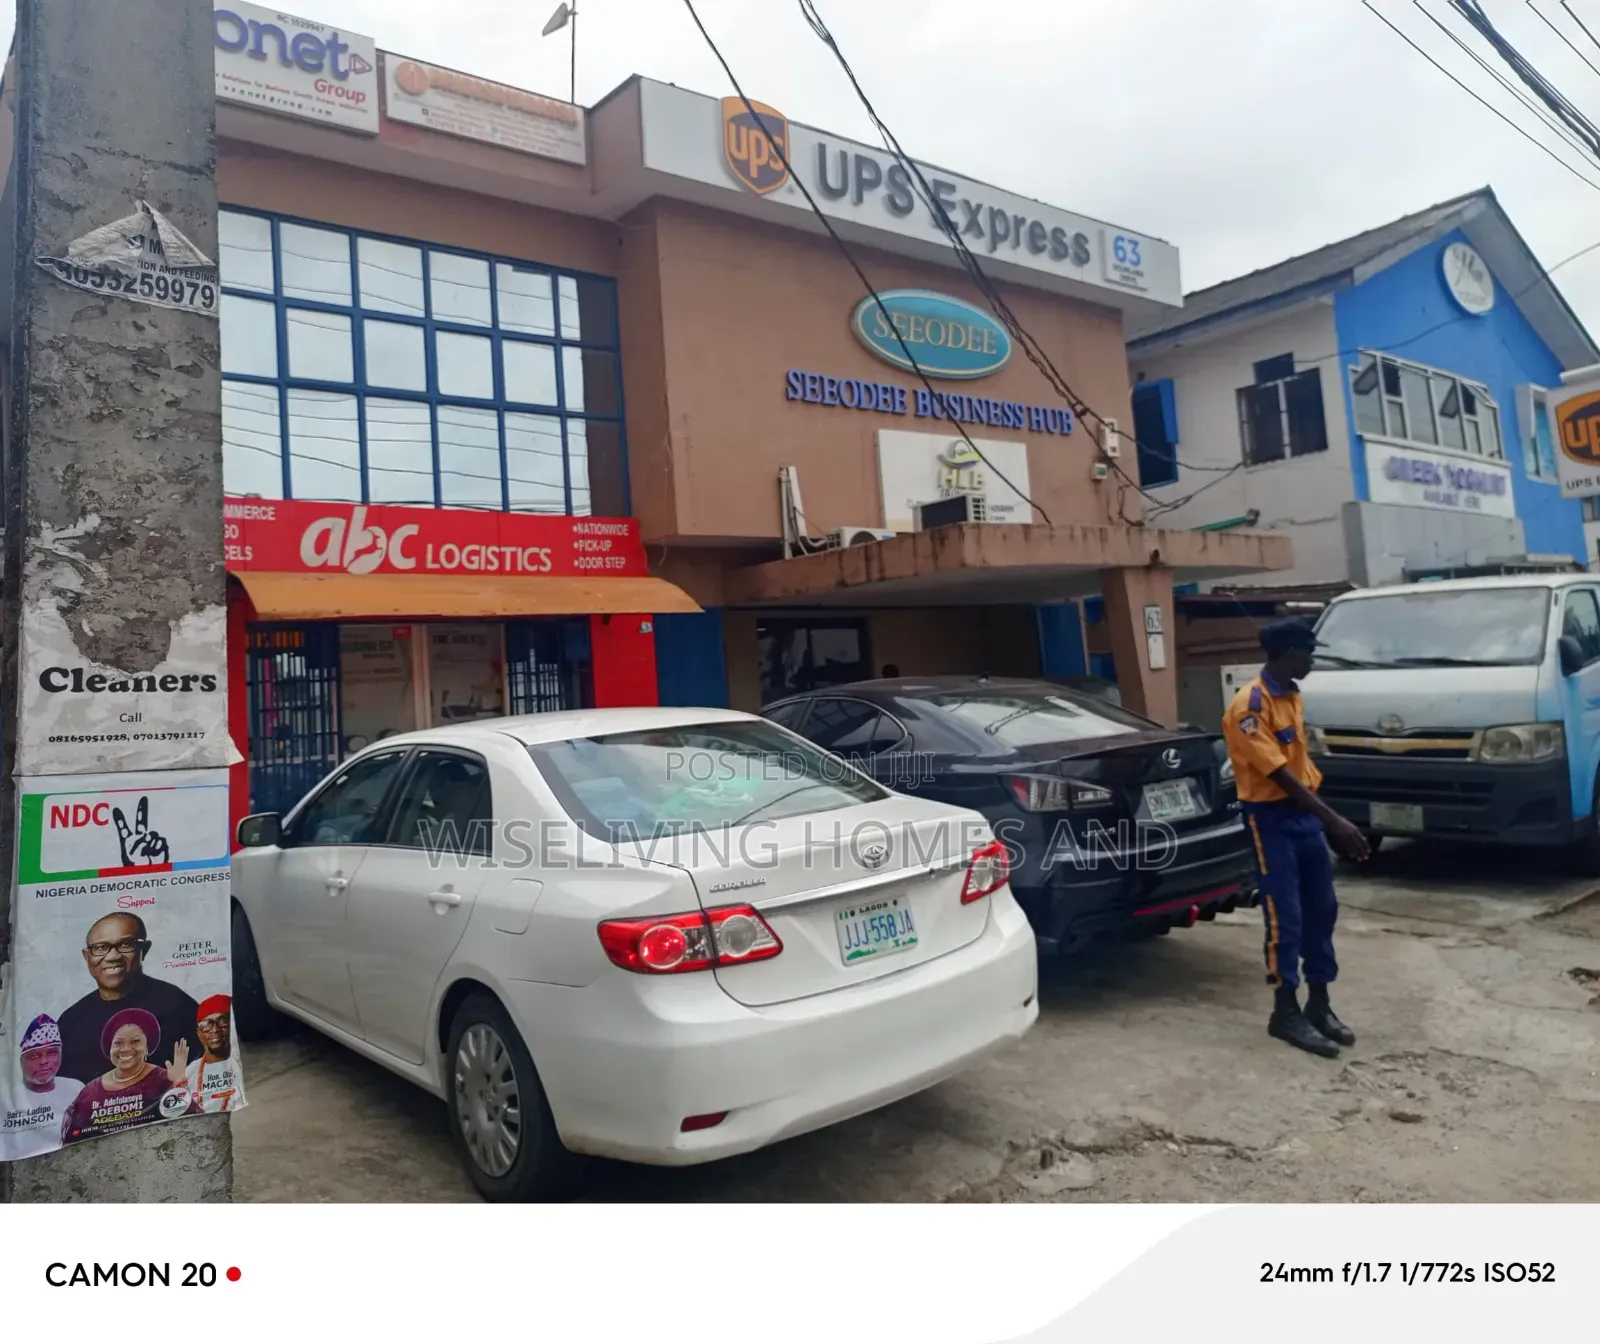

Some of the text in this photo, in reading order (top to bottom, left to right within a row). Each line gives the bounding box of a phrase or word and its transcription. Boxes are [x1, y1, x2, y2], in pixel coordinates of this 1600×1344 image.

[213, 10, 349, 81] onet
[314, 78, 366, 105] Group
[728, 121, 786, 179] ups
[817, 142, 1092, 266] UPS Express
[1113, 234, 1141, 267] 63
[139, 261, 216, 284] ION AND FEEDING
[873, 309, 997, 355] SEEODEE
[786, 368, 1074, 436] SEEODEE BUSINESS HUB
[223, 503, 276, 521] MMERCE
[577, 522, 629, 537] NATIONWIDE
[300, 506, 420, 575] abc
[578, 538, 612, 552] PICK-UP
[425, 543, 552, 573] LOGISTICS
[578, 556, 626, 569] DOOR STEP
[39, 667, 217, 693] Cleaners
[119, 712, 142, 723] Call
[50, 802, 110, 829] NDC
[36, 871, 231, 899] NIGERIA DEMOCRATIC CONGRESS
[709, 877, 766, 893] COROLLA
[117, 896, 156, 909] Support
[858, 901, 889, 914] LAGOS
[172, 947, 218, 960] Gregory Obi
[178, 940, 212, 951] PETER
[27, 1105, 51, 1116] Ladipo
[90, 1101, 144, 1120] ADEBOMI
[92, 1100, 102, 1109] Dr.
[3, 1112, 54, 1128] JOHNSON
